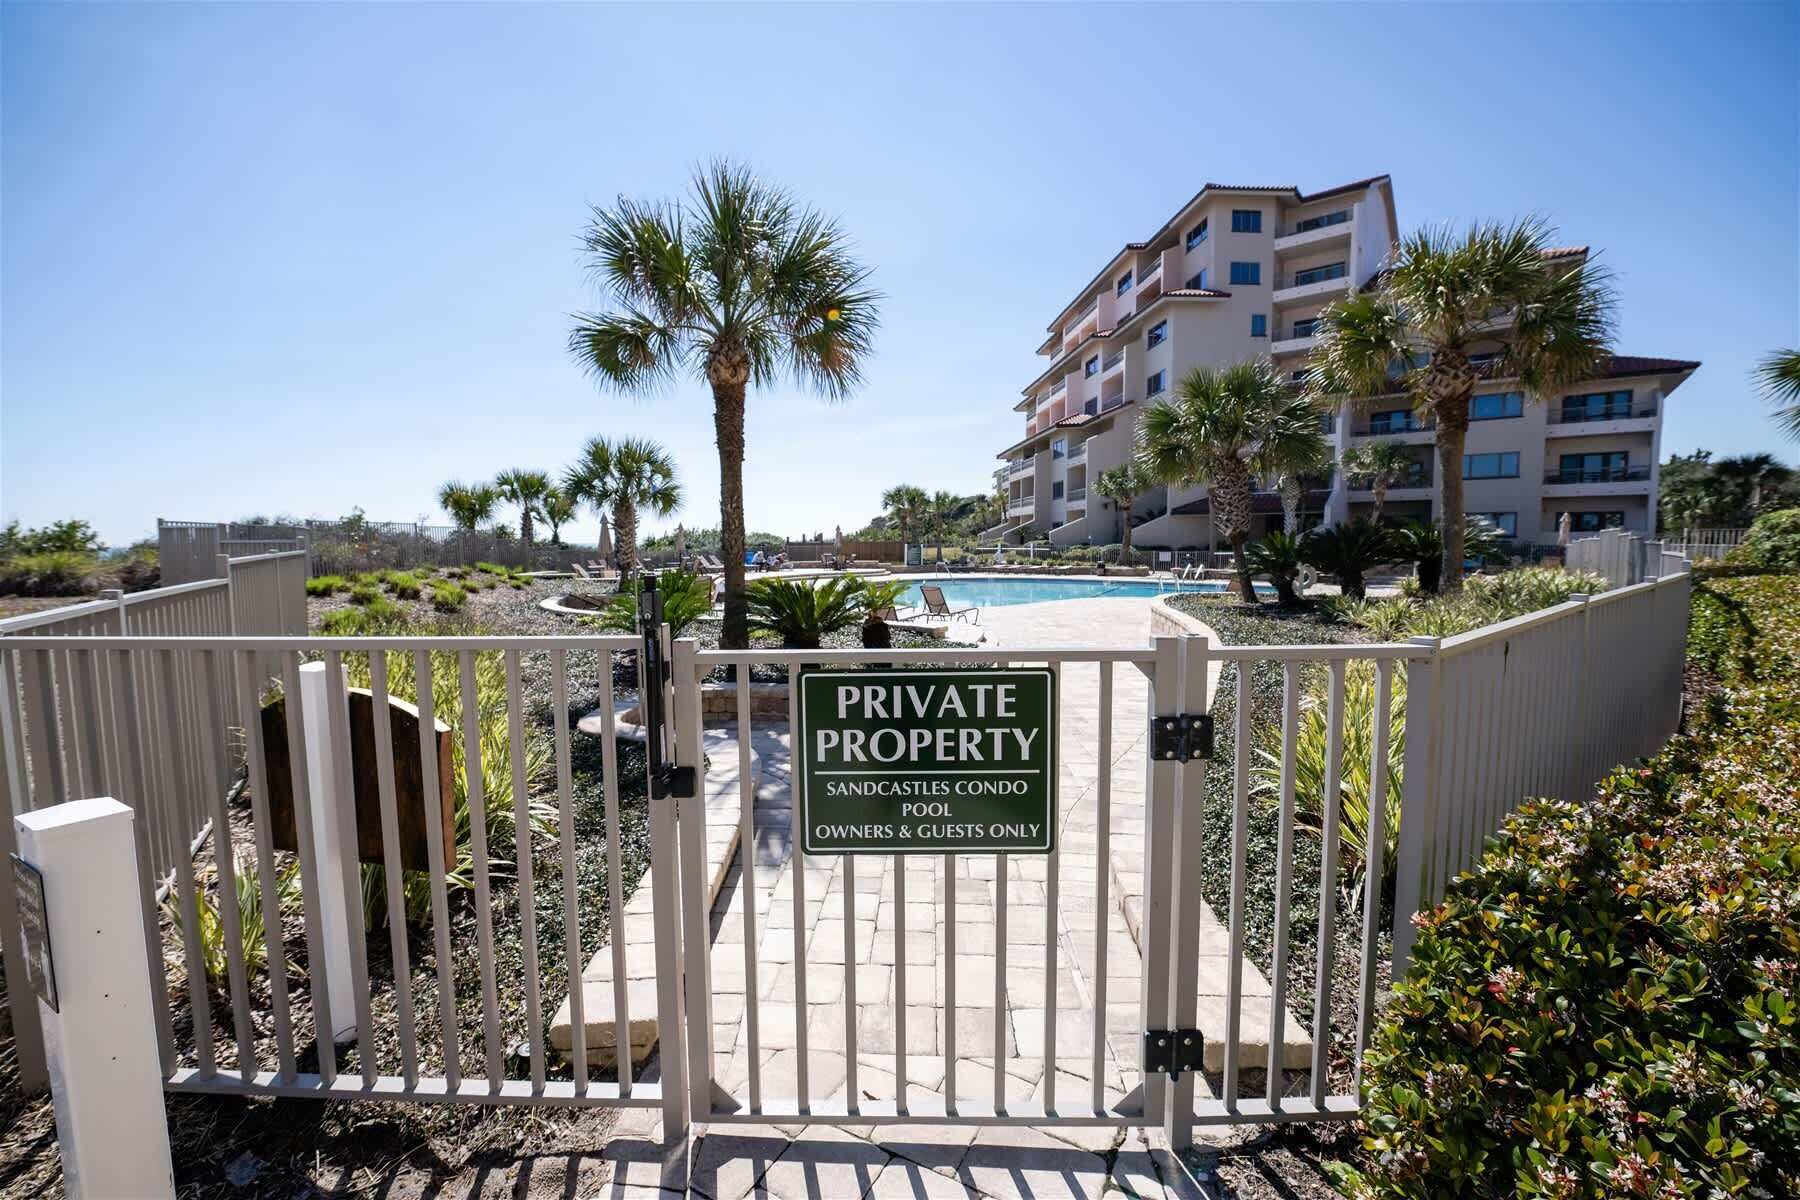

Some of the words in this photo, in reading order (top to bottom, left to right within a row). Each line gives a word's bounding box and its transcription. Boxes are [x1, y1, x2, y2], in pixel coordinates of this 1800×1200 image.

[838, 685, 1016, 718] PRIVATE
[816, 728, 1039, 762] PROPERTY
[827, 781, 950, 796] SANDCASTLES
[955, 780, 1028, 795] CONDO
[902, 803, 952, 817] POOL
[815, 824, 893, 839] OWNERS
[899, 825, 912, 838] &
[917, 823, 984, 838] GUESTS
[989, 823, 1040, 838] ONLY
